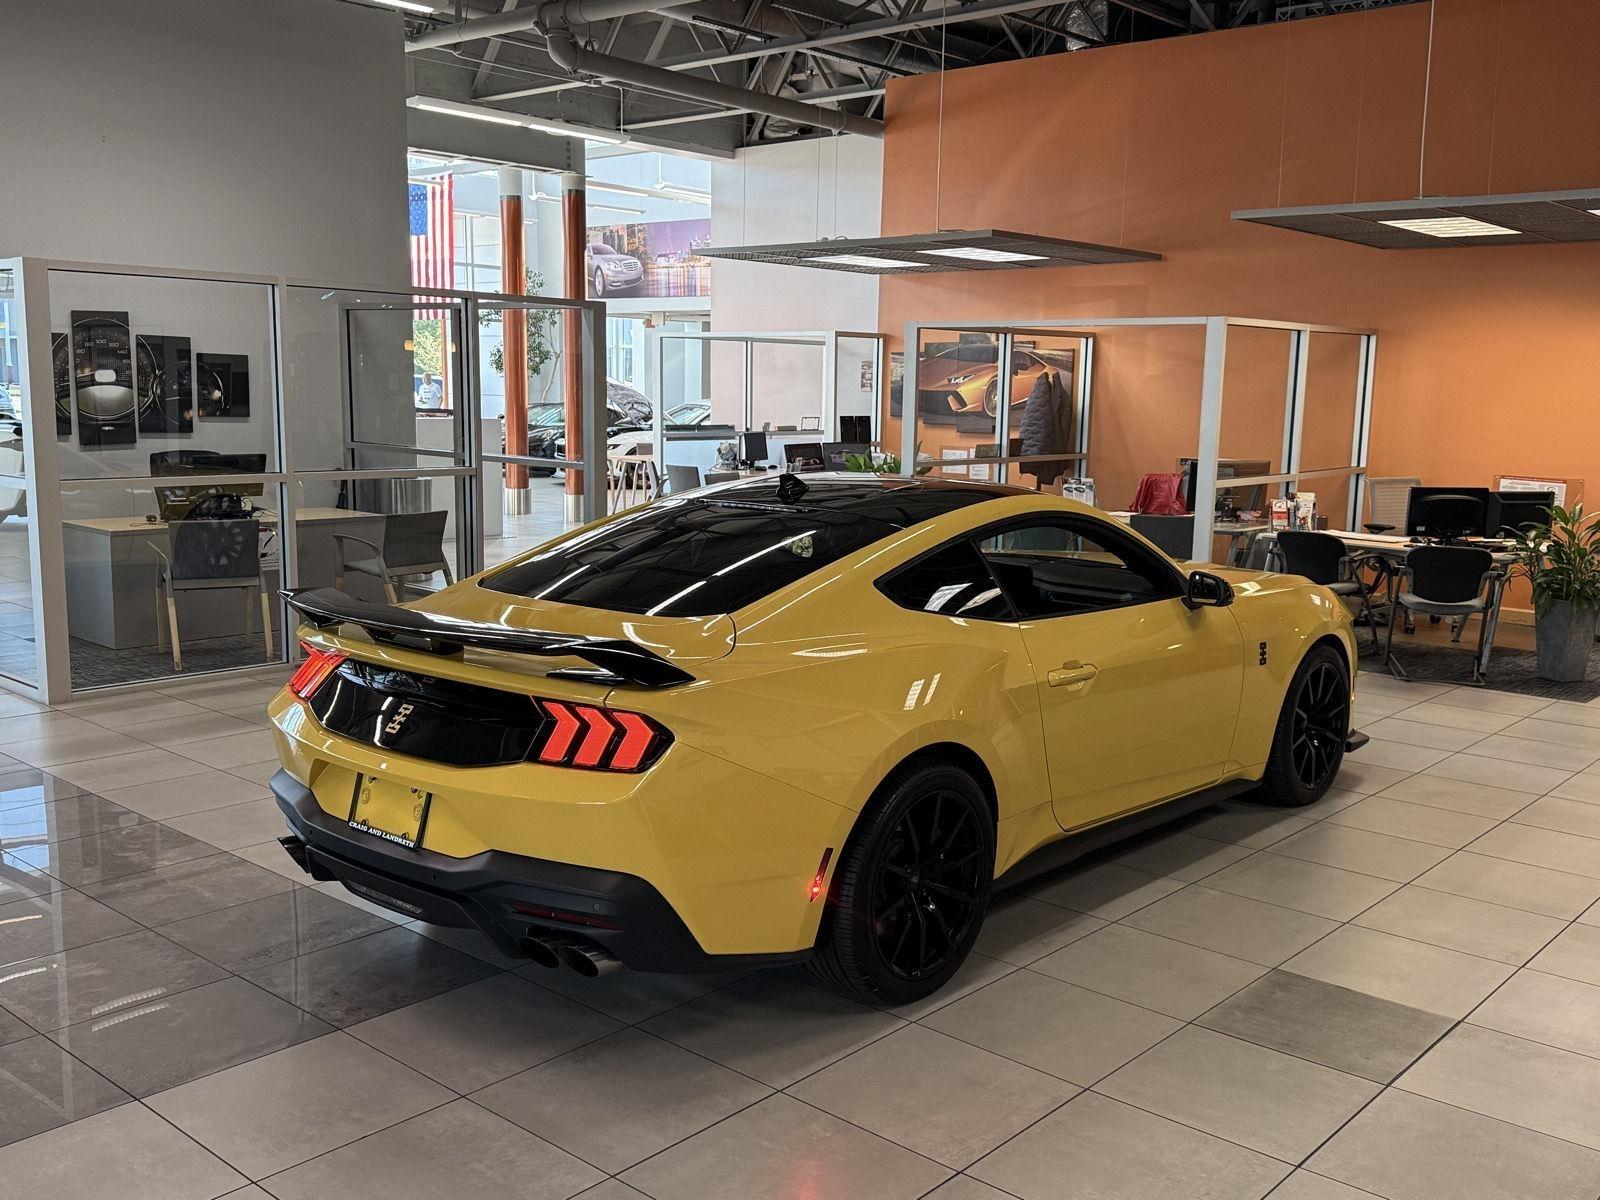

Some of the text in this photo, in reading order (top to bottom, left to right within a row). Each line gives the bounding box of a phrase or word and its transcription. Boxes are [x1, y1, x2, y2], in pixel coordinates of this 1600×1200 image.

[349, 821, 414, 848] CRAIG AND LANDRETH
